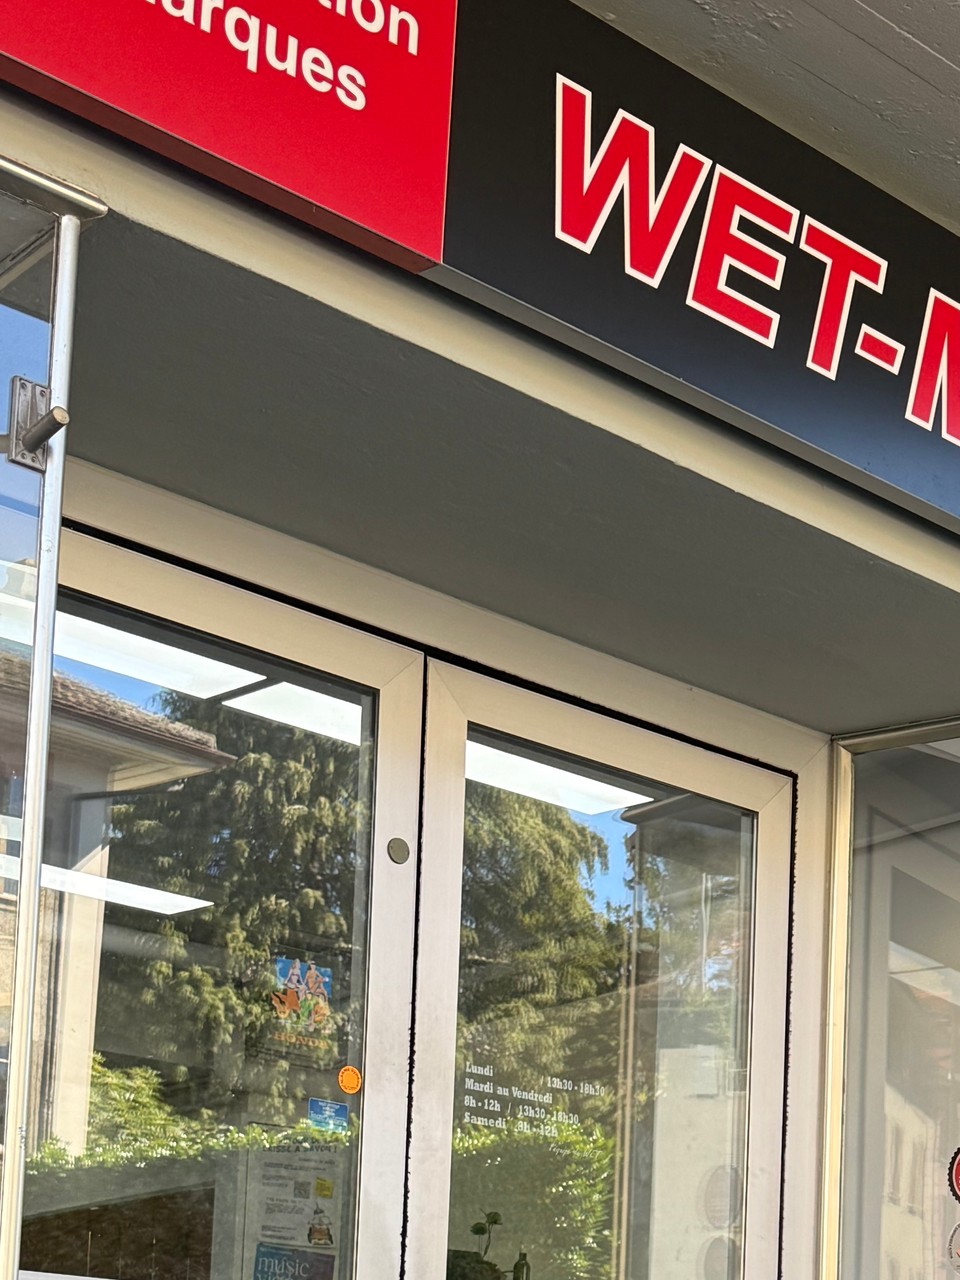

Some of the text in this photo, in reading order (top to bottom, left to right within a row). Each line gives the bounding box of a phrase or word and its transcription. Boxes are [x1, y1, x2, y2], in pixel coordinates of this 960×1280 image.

[145, 0, 366, 110] arques
[465, 1061, 494, 1077] Lundi
[465, 1078, 553, 1104] Mardi au Vendredi
[547, 1076, 573, 1091] 13h30
[580, 1083, 605, 1097] 18h30
[464, 1096, 477, 1107] 8h
[483, 1100, 501, 1112] 12h
[518, 1104, 546, 1119] 13h30
[552, 1110, 579, 1125] 18h30
[464, 1112, 507, 1129] Samedi
[257, 1256, 310, 1278] music
